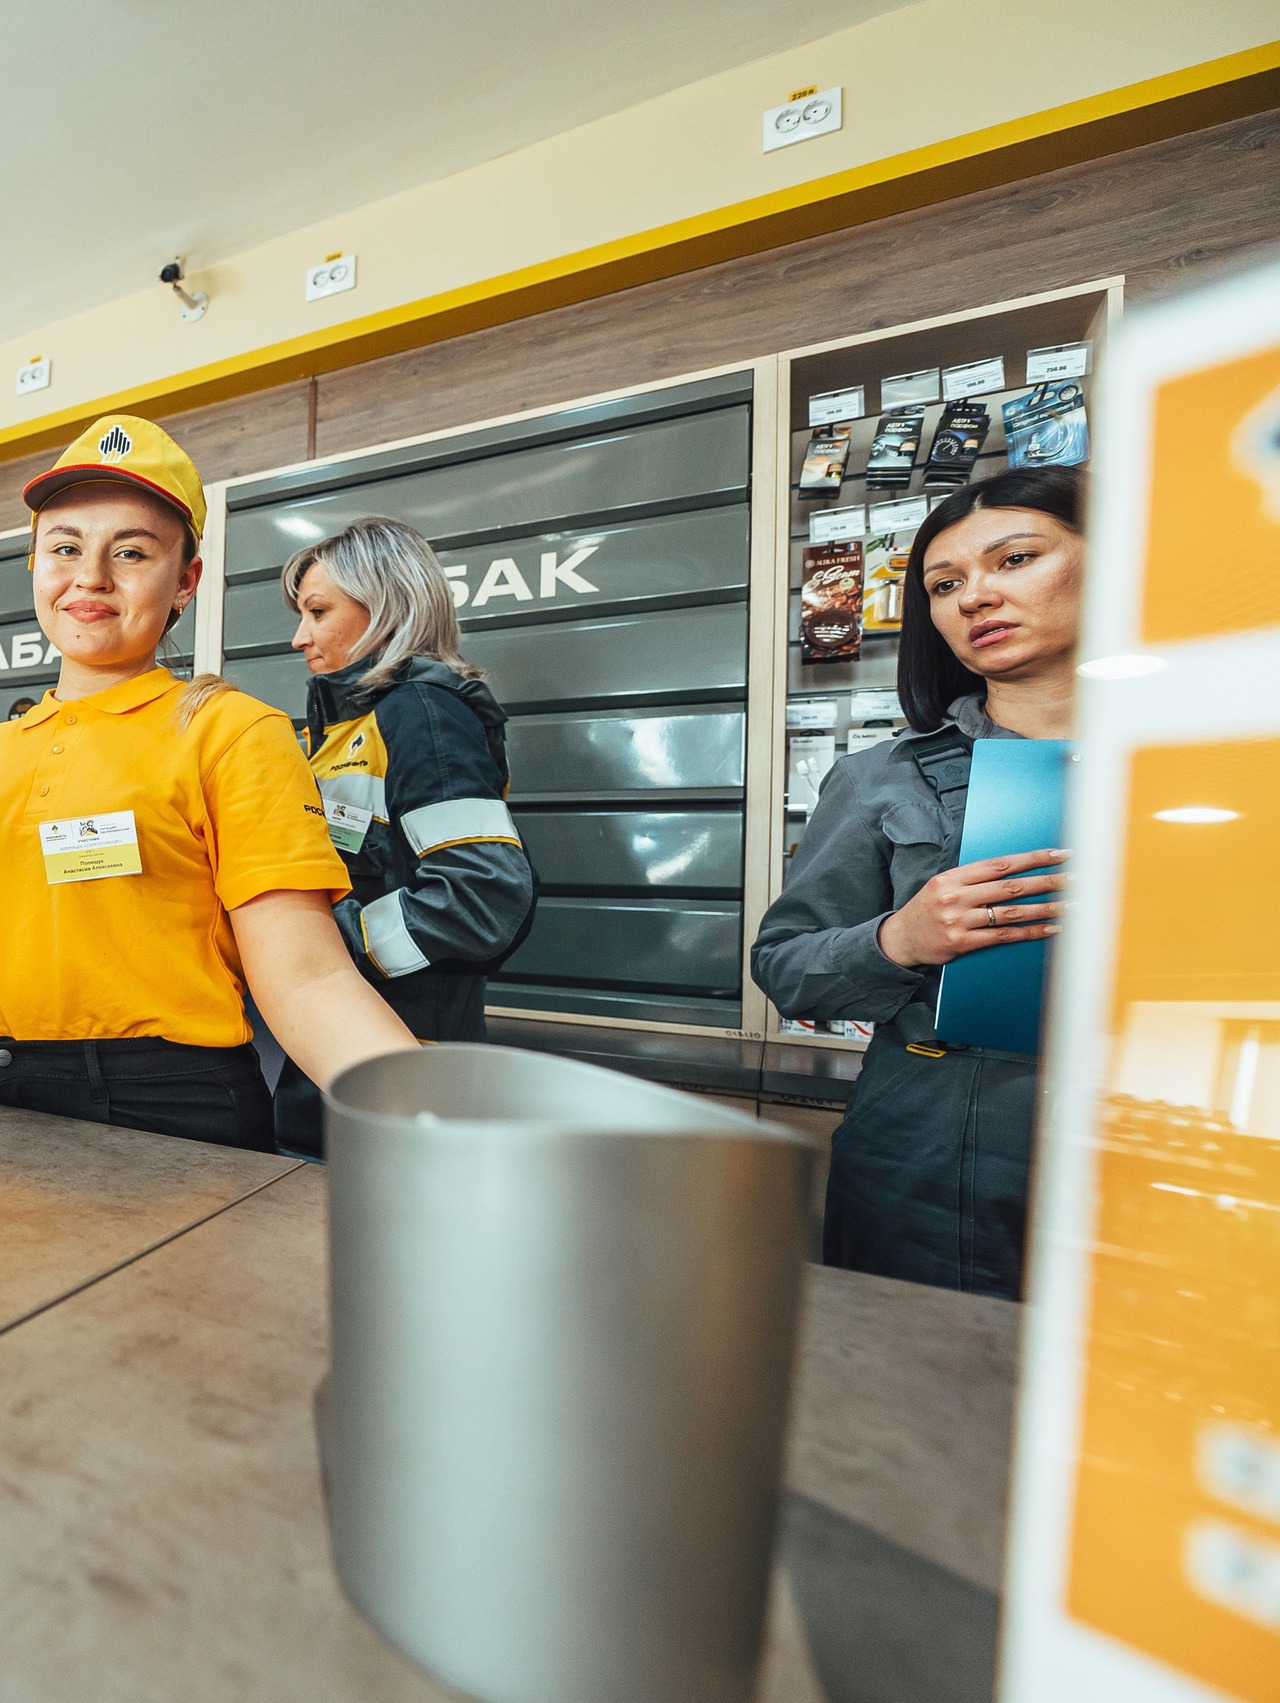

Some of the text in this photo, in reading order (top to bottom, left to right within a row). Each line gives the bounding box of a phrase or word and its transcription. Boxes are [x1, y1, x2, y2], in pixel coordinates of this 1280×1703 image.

[837, 555, 860, 564] FRESH
[63, 862, 123, 874] Анастасия Алексеевна
